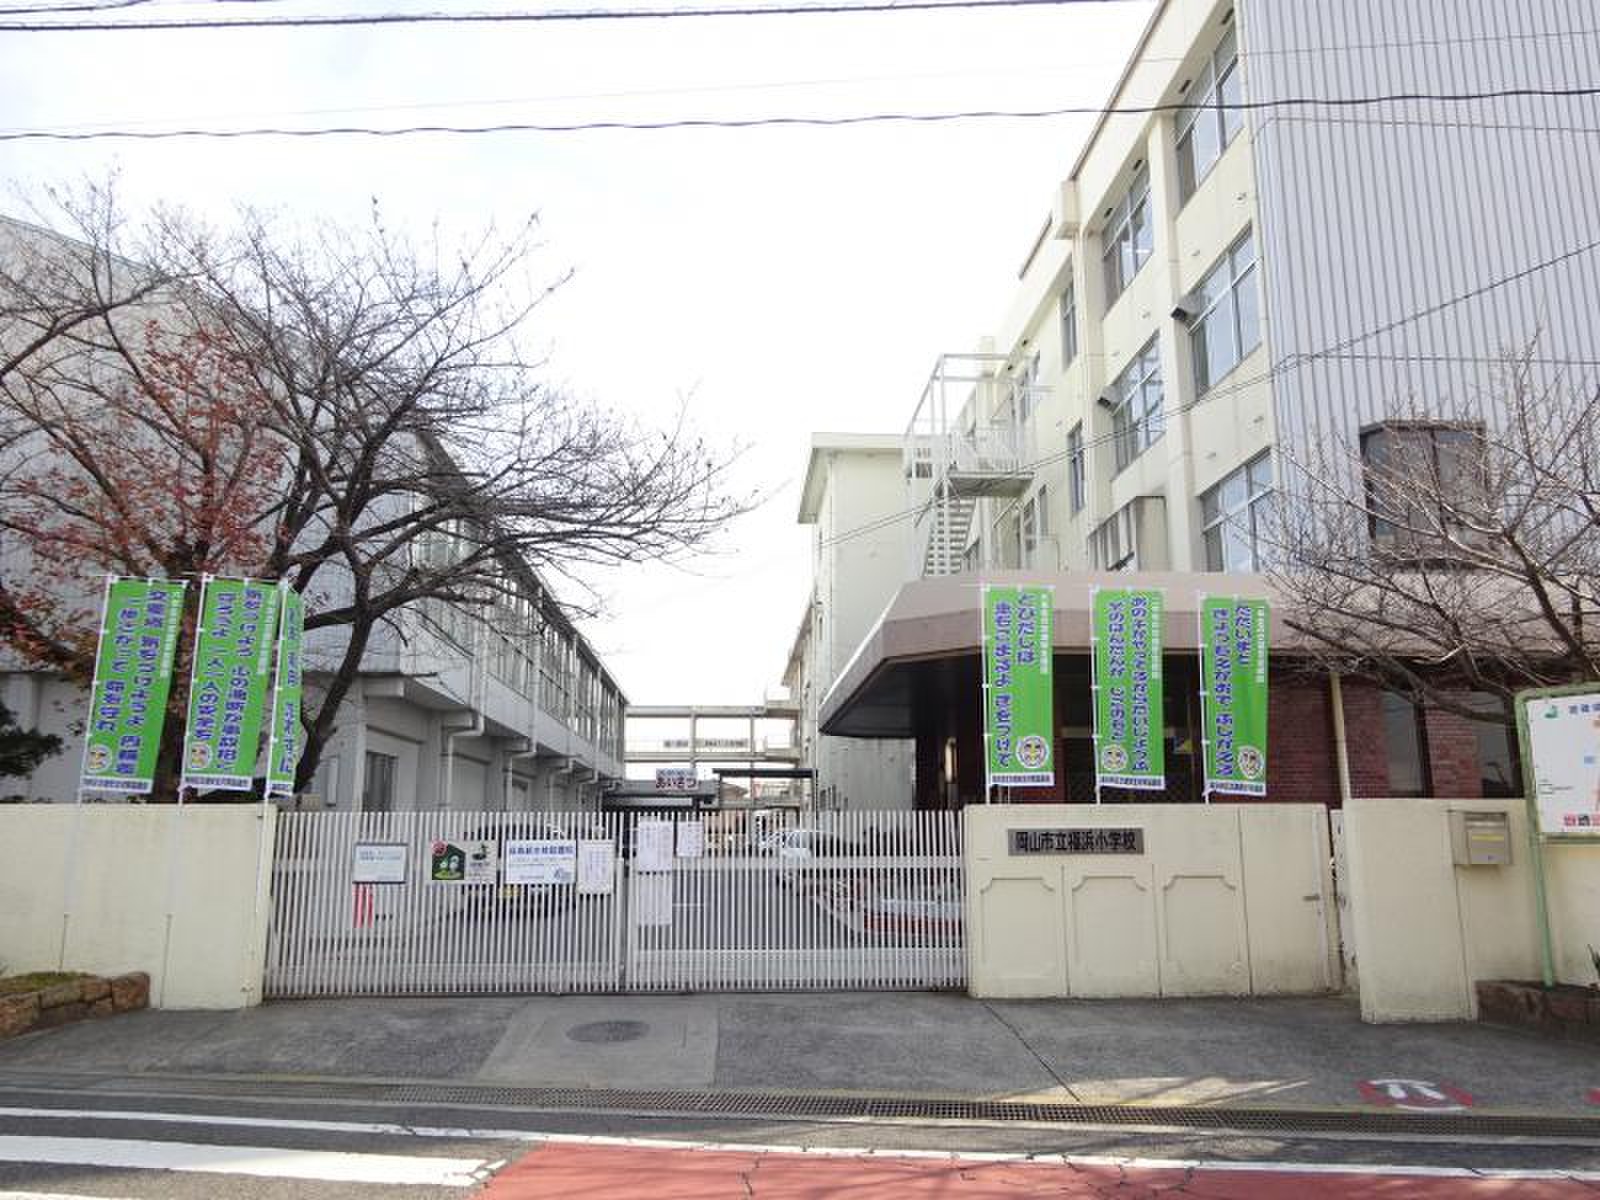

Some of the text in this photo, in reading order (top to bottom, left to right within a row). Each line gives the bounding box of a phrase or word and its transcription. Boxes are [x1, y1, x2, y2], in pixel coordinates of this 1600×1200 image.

[1015, 831, 1136, 852] 岡山市立福浜小学校
